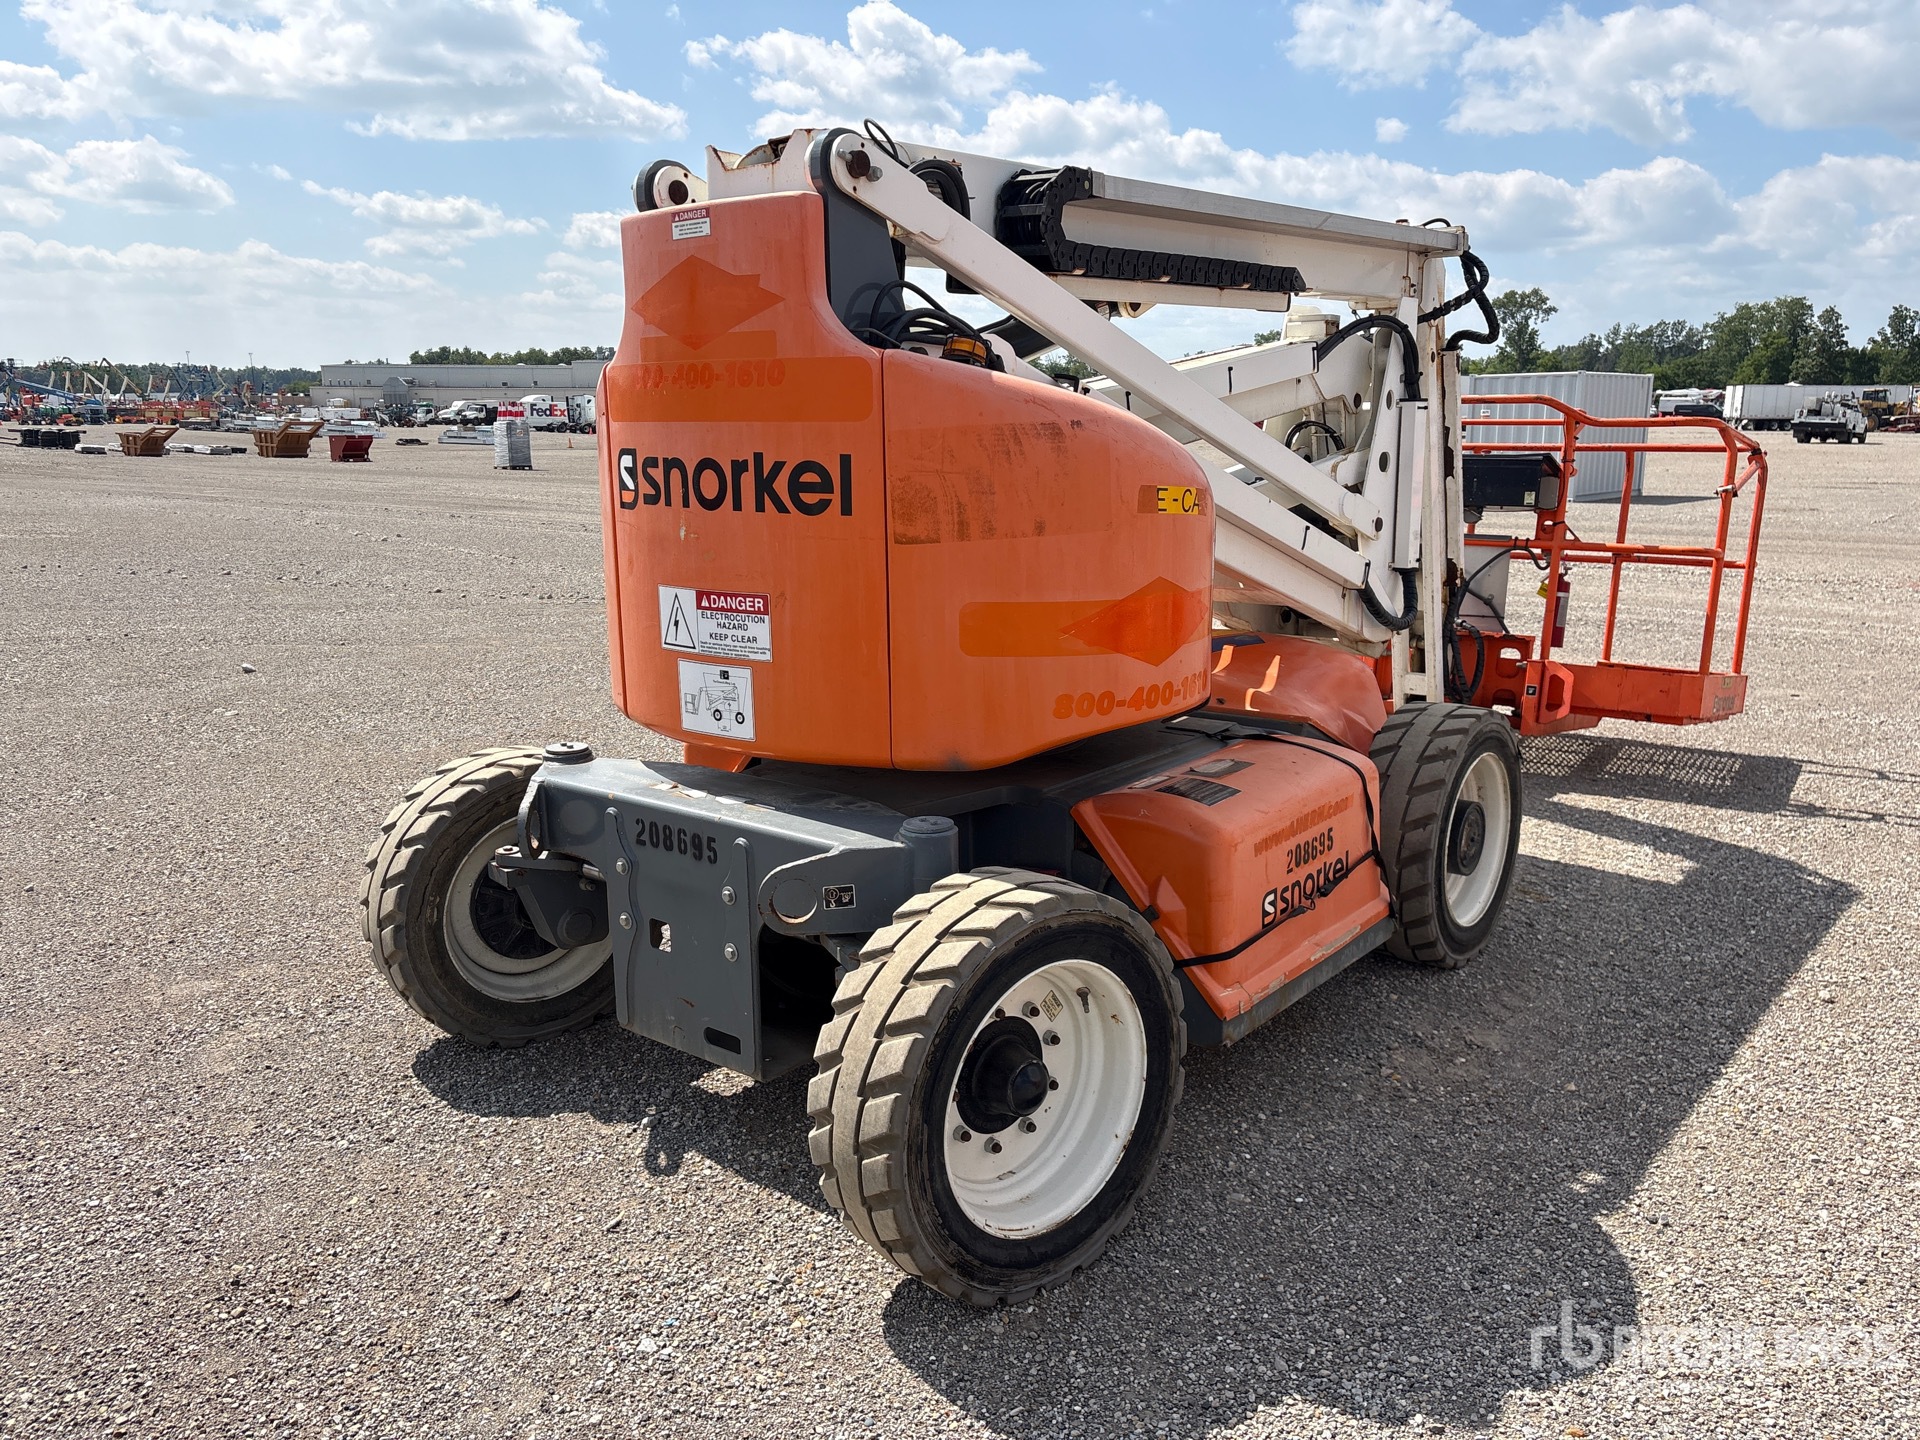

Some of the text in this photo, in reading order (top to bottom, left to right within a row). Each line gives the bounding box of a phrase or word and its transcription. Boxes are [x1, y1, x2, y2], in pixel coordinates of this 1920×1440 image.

[679, 208, 707, 221] DANGER
[529, 403, 567, 417] FedEx
[641, 451, 853, 517] snorkel
[710, 594, 764, 611] DANGER
[701, 610, 765, 624] ELECTROCUTION
[716, 621, 749, 632] HAZARD
[709, 632, 758, 645] KEEP CLEAR
[1053, 669, 1207, 719] 800-400-1610
[635, 818, 718, 865] 208695
[1286, 827, 1334, 875] 208695
